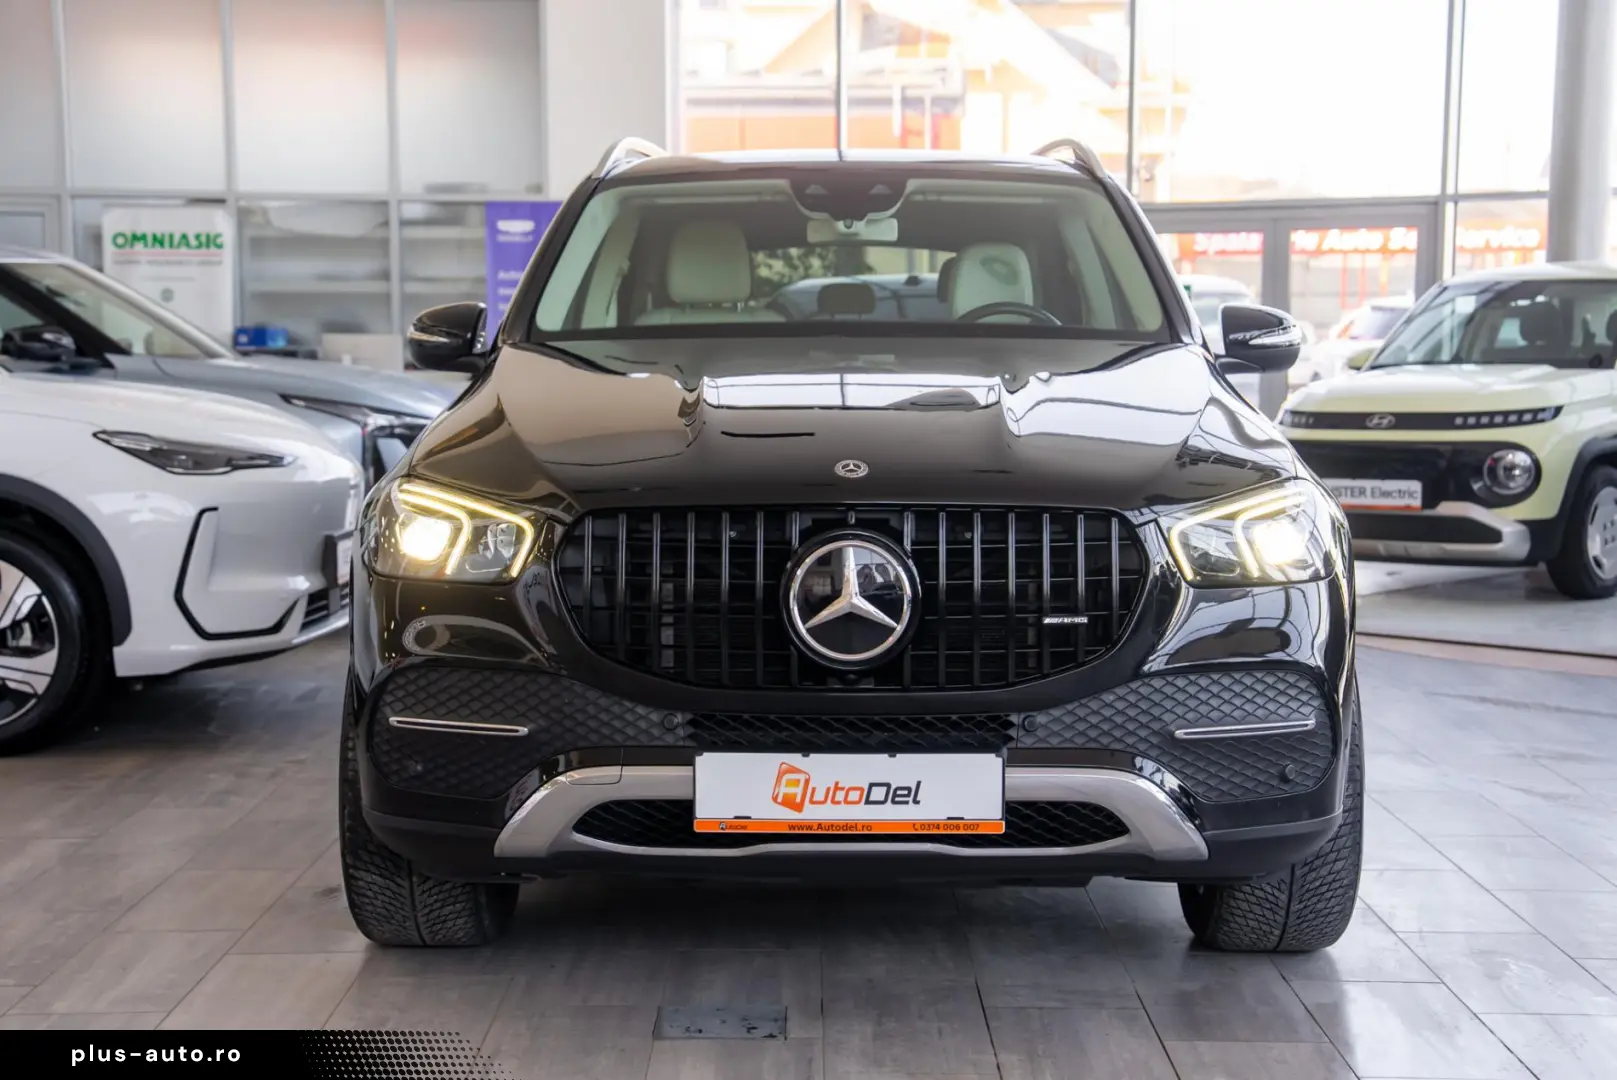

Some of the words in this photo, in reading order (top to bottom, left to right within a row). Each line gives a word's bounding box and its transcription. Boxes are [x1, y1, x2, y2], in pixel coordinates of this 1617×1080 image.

[111, 231, 224, 250] OMNIASIG
[1321, 228, 1384, 251] Auto
[1370, 486, 1419, 500] Electric
[771, 761, 922, 814] AutoDel
[787, 823, 873, 832] www.Autodel.ro
[920, 823, 941, 832] 0374
[943, 824, 961, 832] 006
[962, 824, 980, 832] 007
